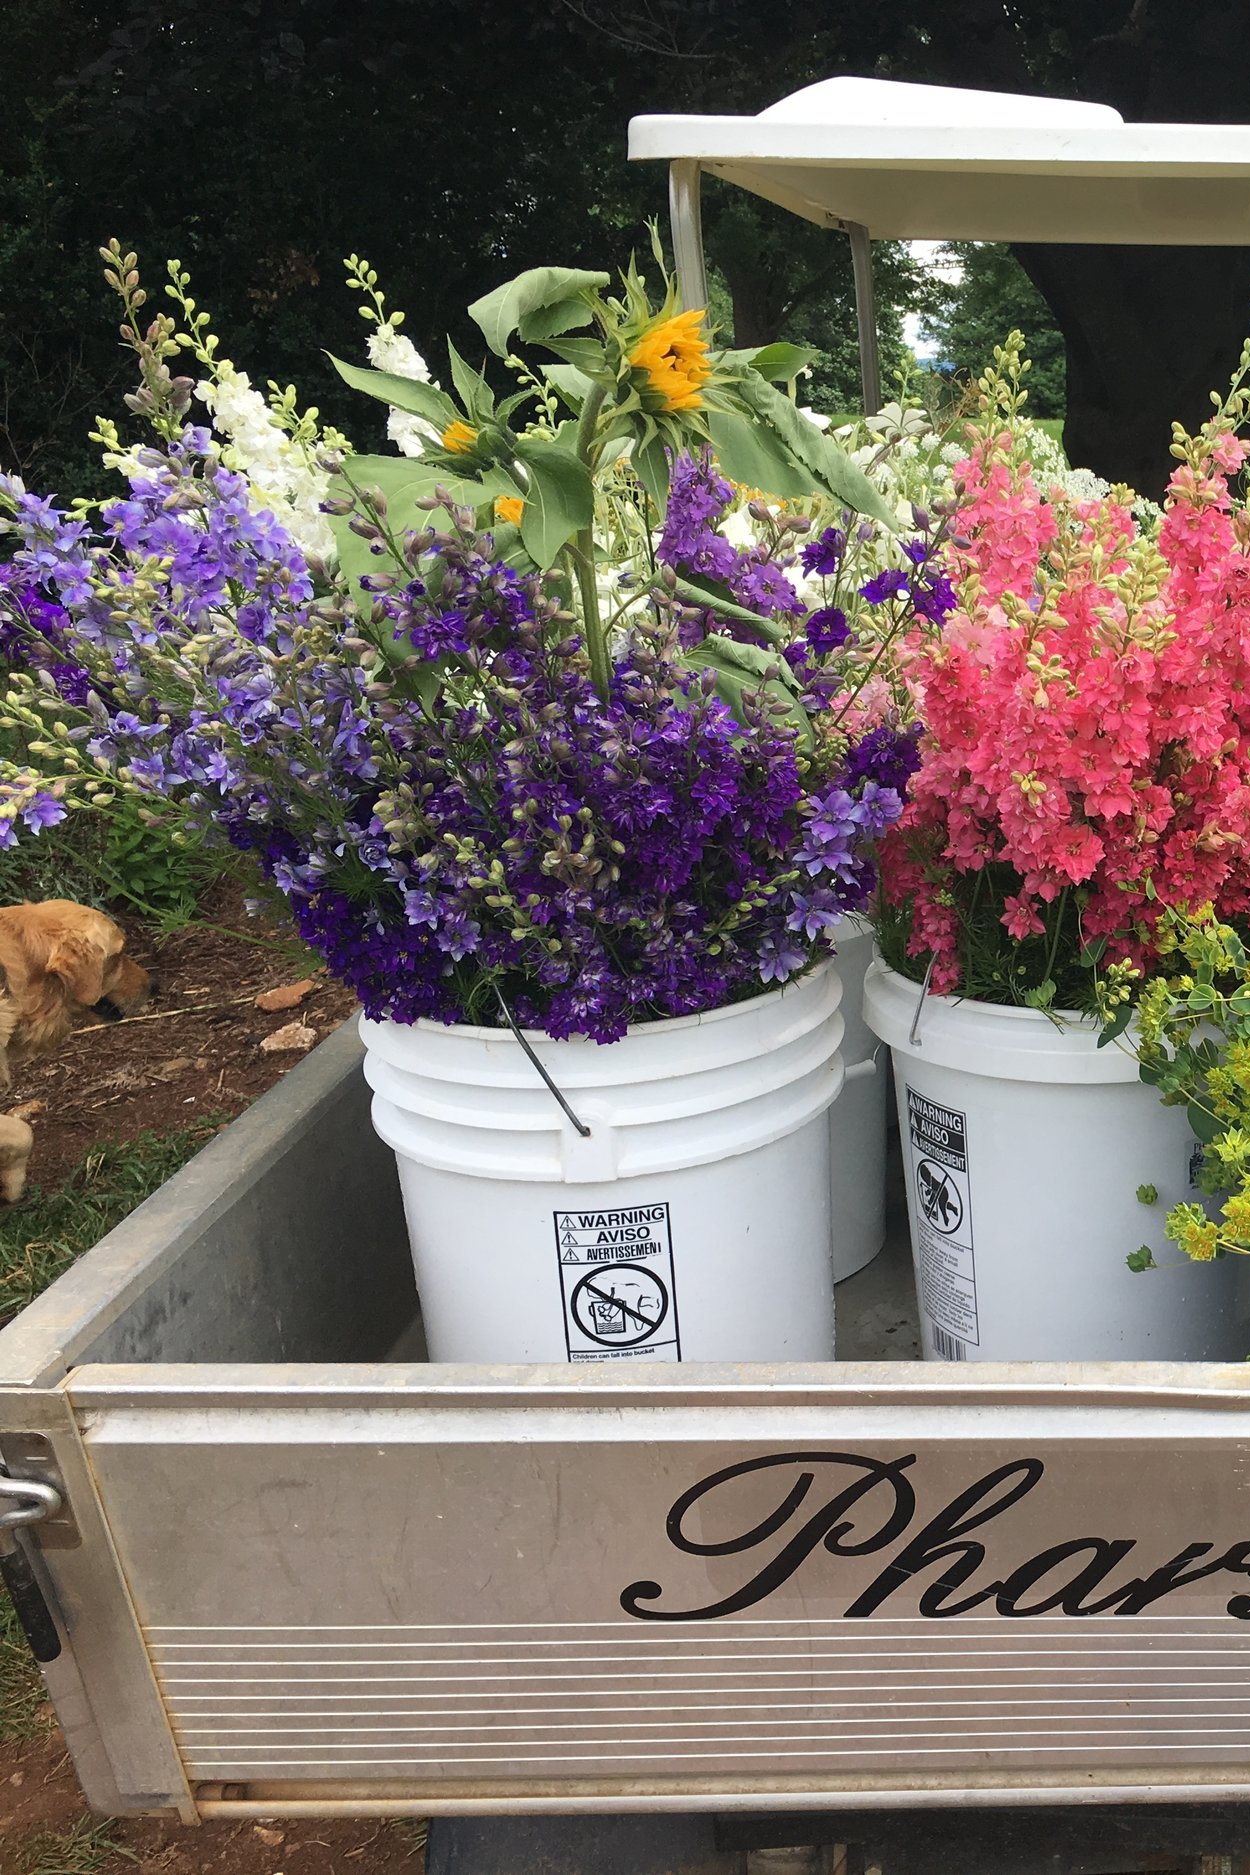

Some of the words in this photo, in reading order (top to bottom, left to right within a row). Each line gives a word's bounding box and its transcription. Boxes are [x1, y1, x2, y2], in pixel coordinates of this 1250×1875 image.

[915, 1098, 962, 1131] WARNING
[921, 1119, 949, 1145] AVISO
[578, 1207, 665, 1228] WARNING
[596, 1226, 650, 1244] AVISO
[634, 1348, 655, 1356] bucket
